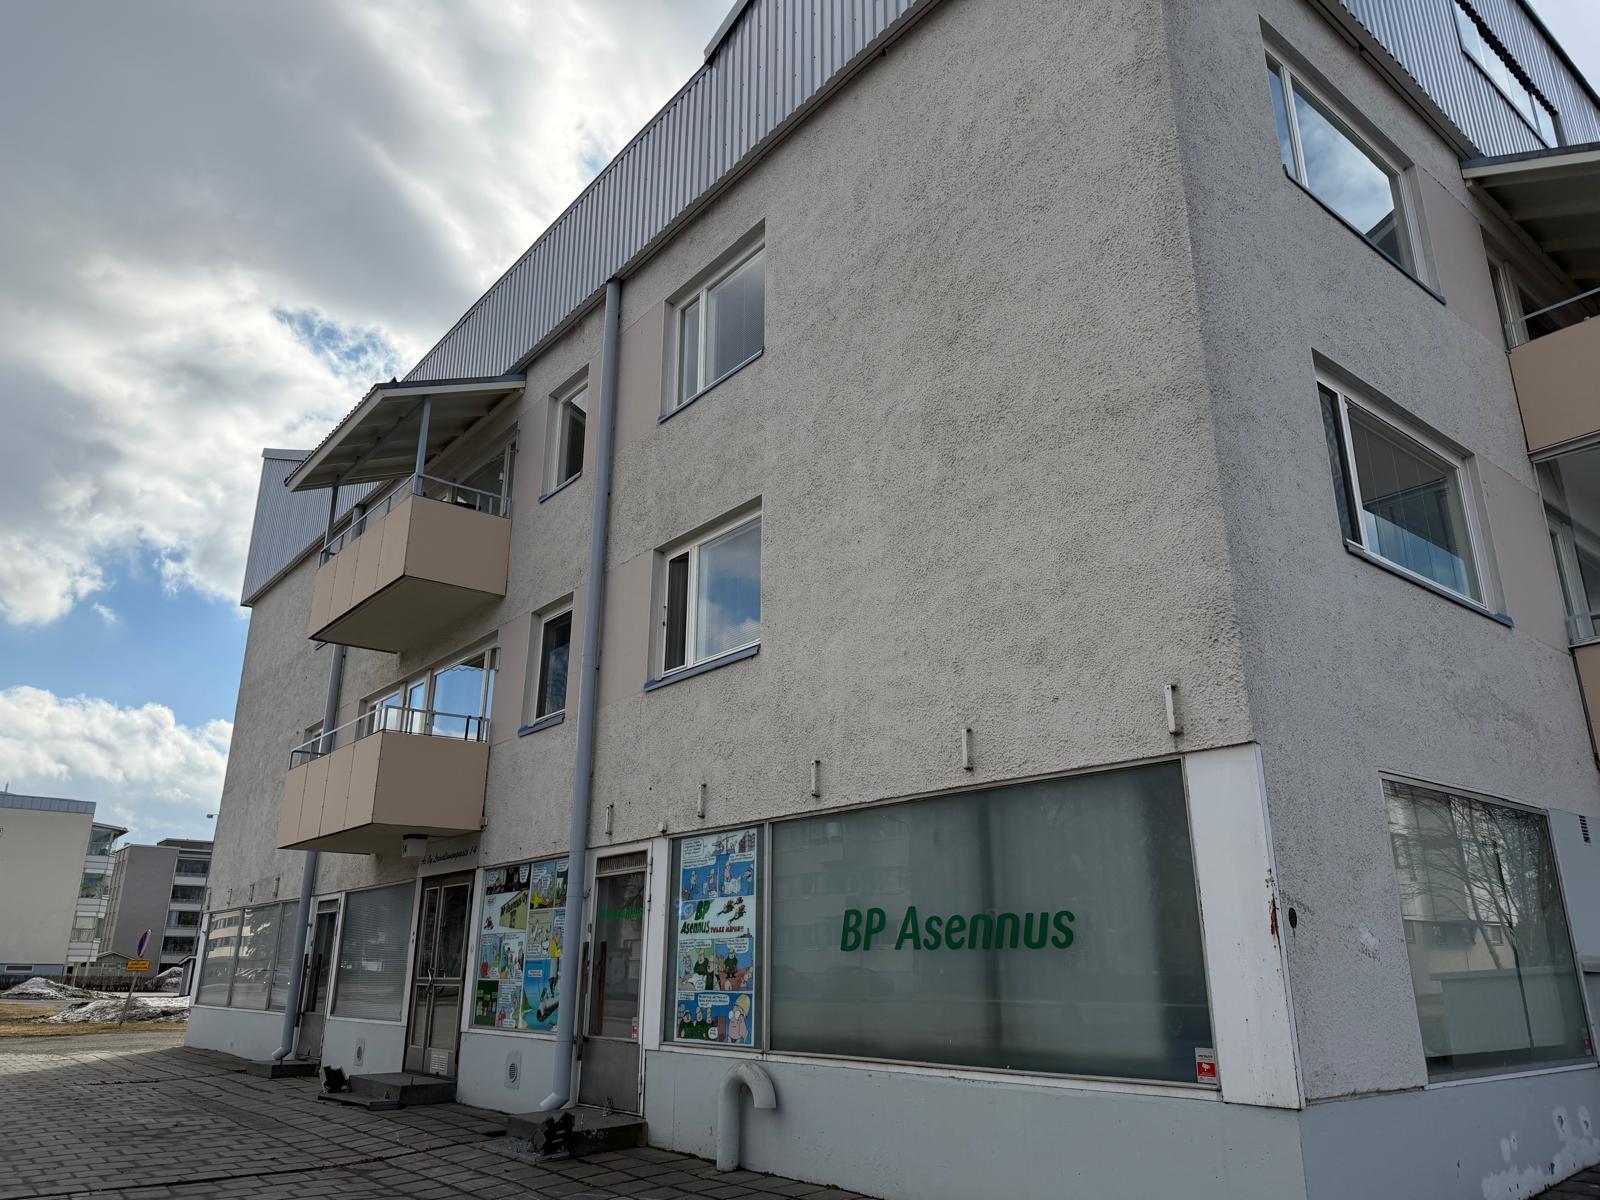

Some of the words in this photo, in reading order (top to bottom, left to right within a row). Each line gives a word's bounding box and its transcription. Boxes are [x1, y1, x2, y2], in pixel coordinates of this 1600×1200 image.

[694, 900, 710, 921] BP
[680, 920, 710, 935] Asennus
[840, 907, 886, 951] BP
[894, 905, 1075, 951] Asennus
